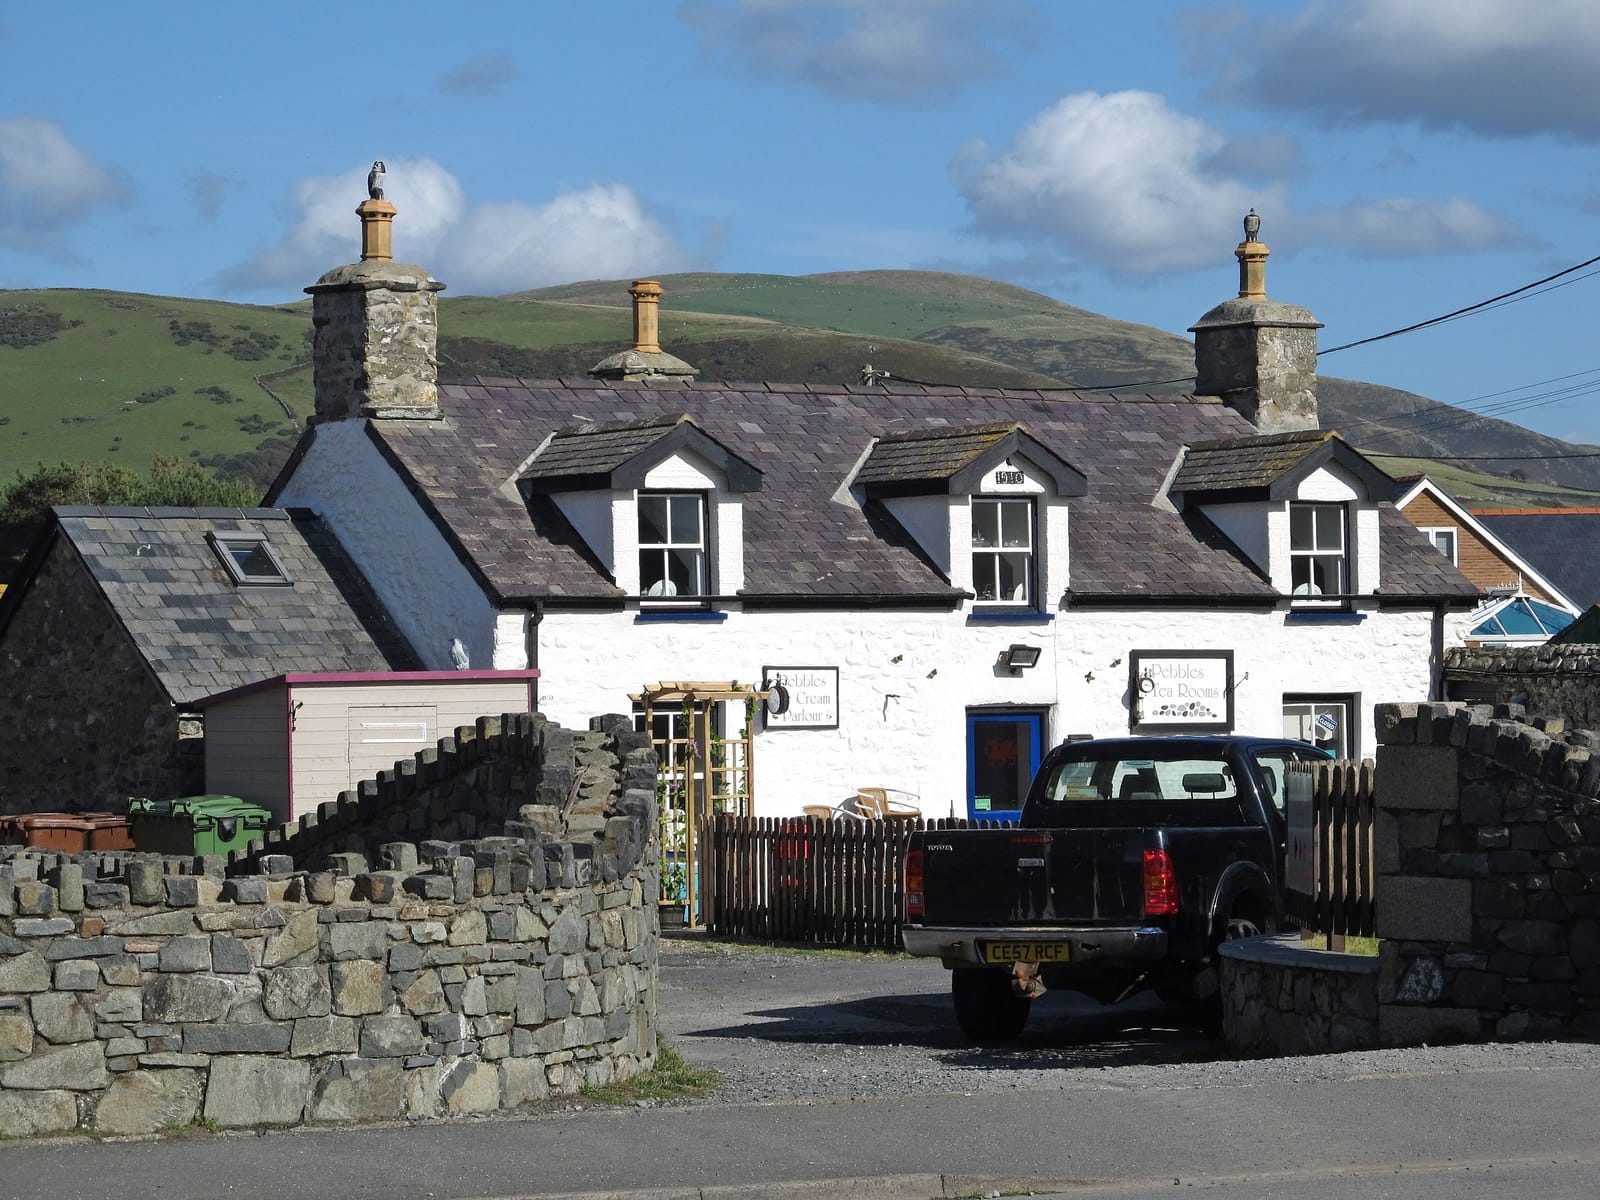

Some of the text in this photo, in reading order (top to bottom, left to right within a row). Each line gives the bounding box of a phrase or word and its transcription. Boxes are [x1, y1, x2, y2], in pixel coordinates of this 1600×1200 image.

[1152, 663, 1204, 679] Pebbles
[779, 673, 827, 688] Pebbles
[1151, 682, 1219, 698] Tea Rooms
[796, 691, 831, 705] Cream
[783, 708, 822, 722] Parlour
[992, 945, 1063, 960] CE57 RCF
